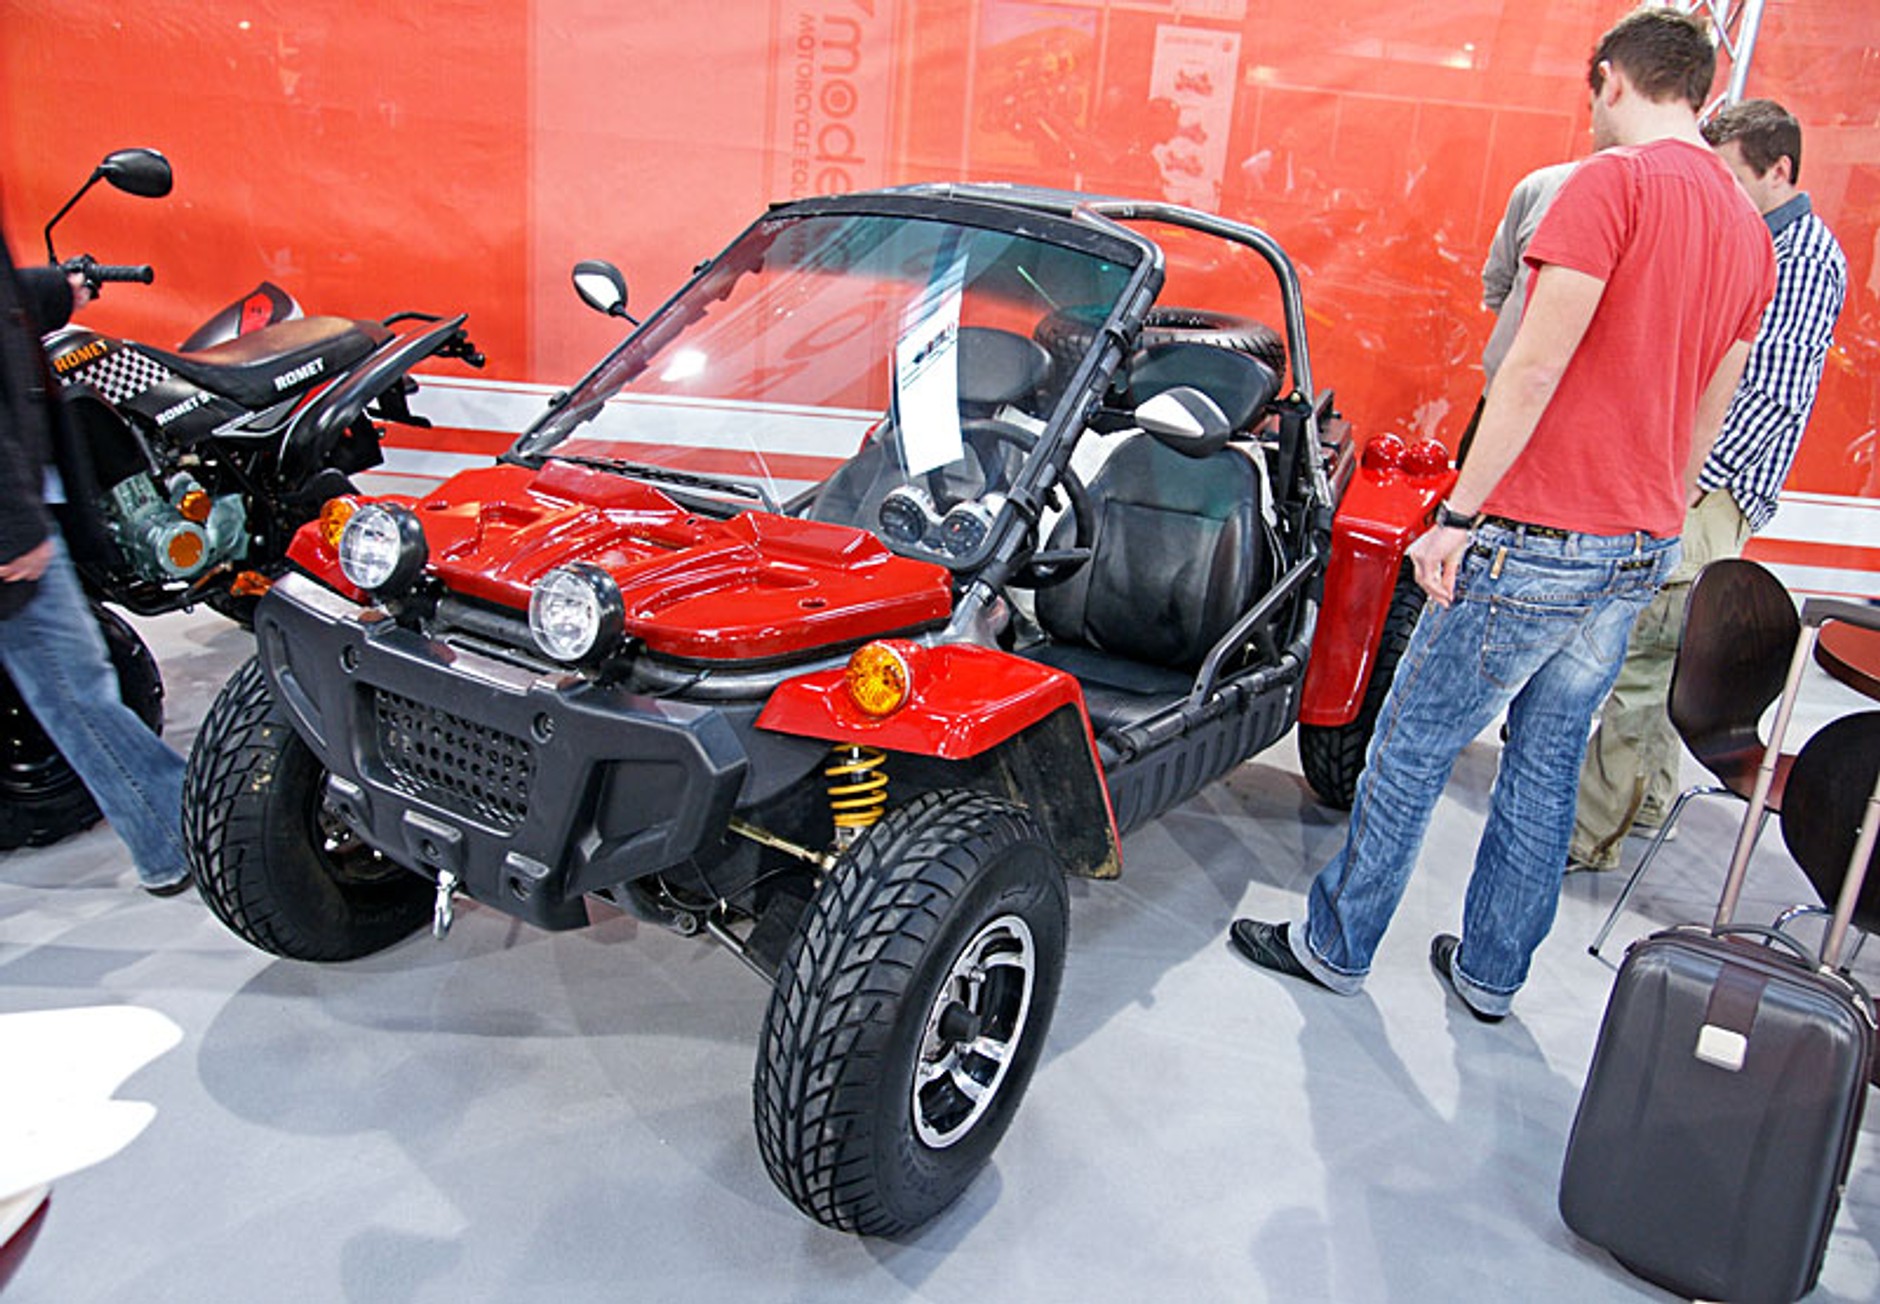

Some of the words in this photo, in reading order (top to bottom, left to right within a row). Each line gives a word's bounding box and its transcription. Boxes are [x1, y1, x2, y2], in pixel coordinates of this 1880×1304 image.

[793, 13, 815, 150] MOTORCYCLE
[53, 338, 109, 373] ROMET
[273, 357, 325, 392] ROMET
[154, 395, 200, 426] ROMET
